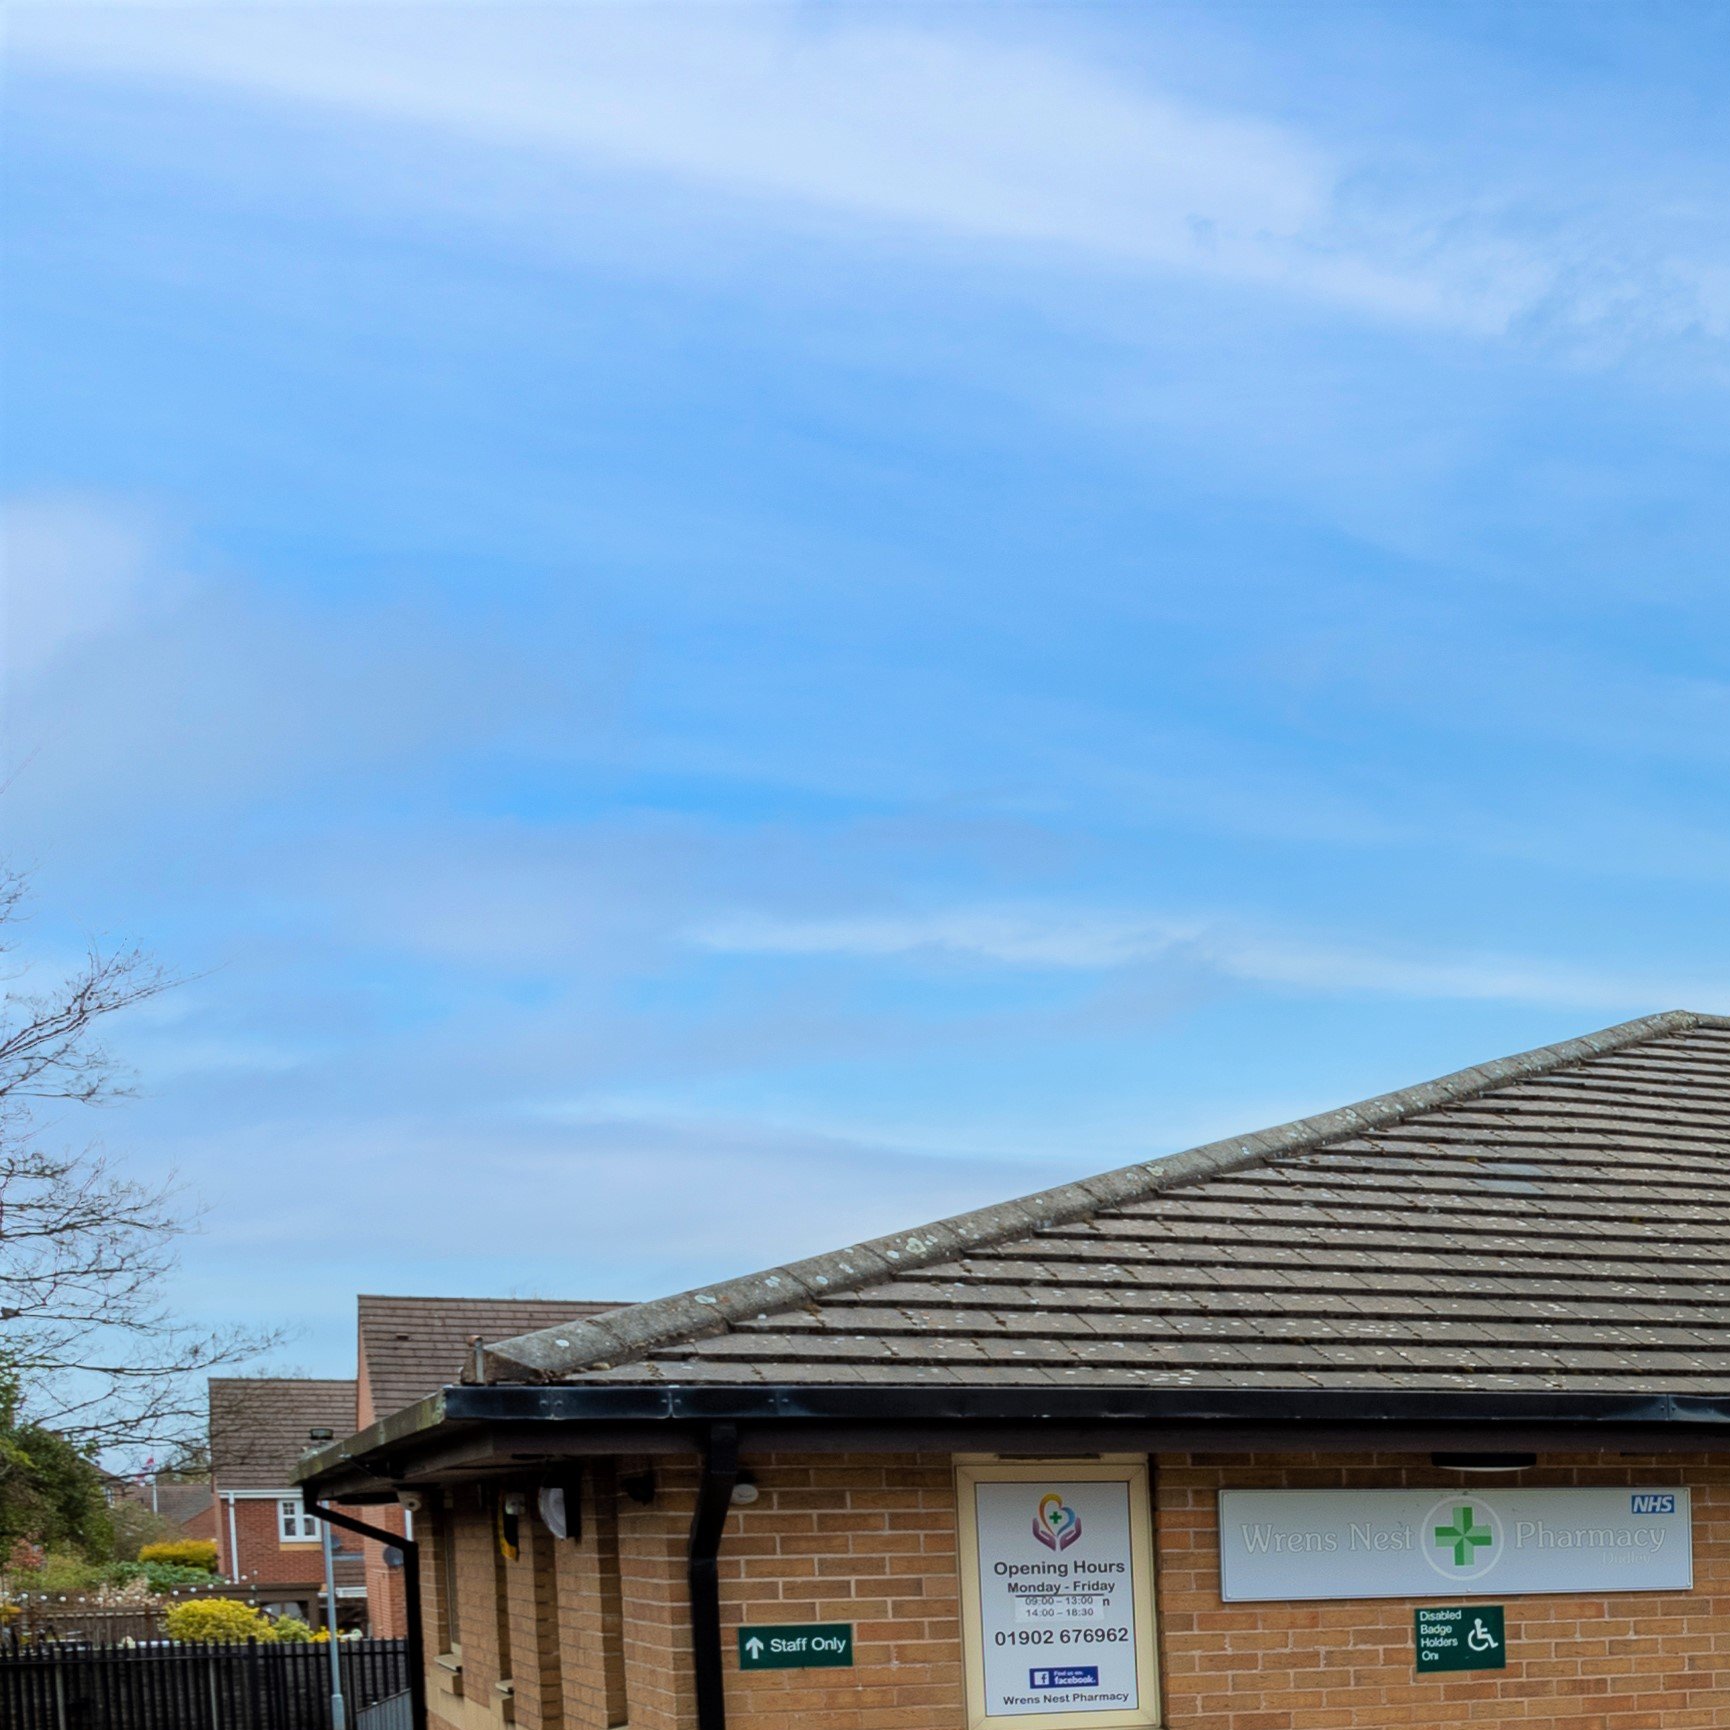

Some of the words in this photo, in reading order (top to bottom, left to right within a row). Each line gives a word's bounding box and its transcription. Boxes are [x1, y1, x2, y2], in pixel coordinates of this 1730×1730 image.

[1632, 1496, 1673, 1513] NHS
[1241, 1522, 1339, 1554] Wrens
[1348, 1521, 1415, 1552] Nest
[1515, 1519, 1667, 1554] Pharmacy
[993, 1561, 1068, 1578] Opening
[1073, 1560, 1125, 1574] Hours
[1007, 1582, 1061, 1595] Monday
[1073, 1580, 1115, 1593] Friday
[1025, 1596, 1055, 1606] 09:00
[1065, 1596, 1093, 1605] 13:00
[1026, 1609, 1055, 1617] 14:00
[1066, 1608, 1094, 1616] 18:30
[1420, 1610, 1462, 1621] Disabled
[994, 1630, 1054, 1646] 01902
[1060, 1627, 1129, 1644] 676962
[1420, 1624, 1453, 1636] Badge
[770, 1637, 808, 1652] Staff
[811, 1636, 846, 1654] Only
[1421, 1637, 1458, 1648] Holders
[1003, 1695, 1040, 1705] Wrens
[1043, 1694, 1070, 1703] Nest
[1073, 1692, 1129, 1702] Pharmacy
